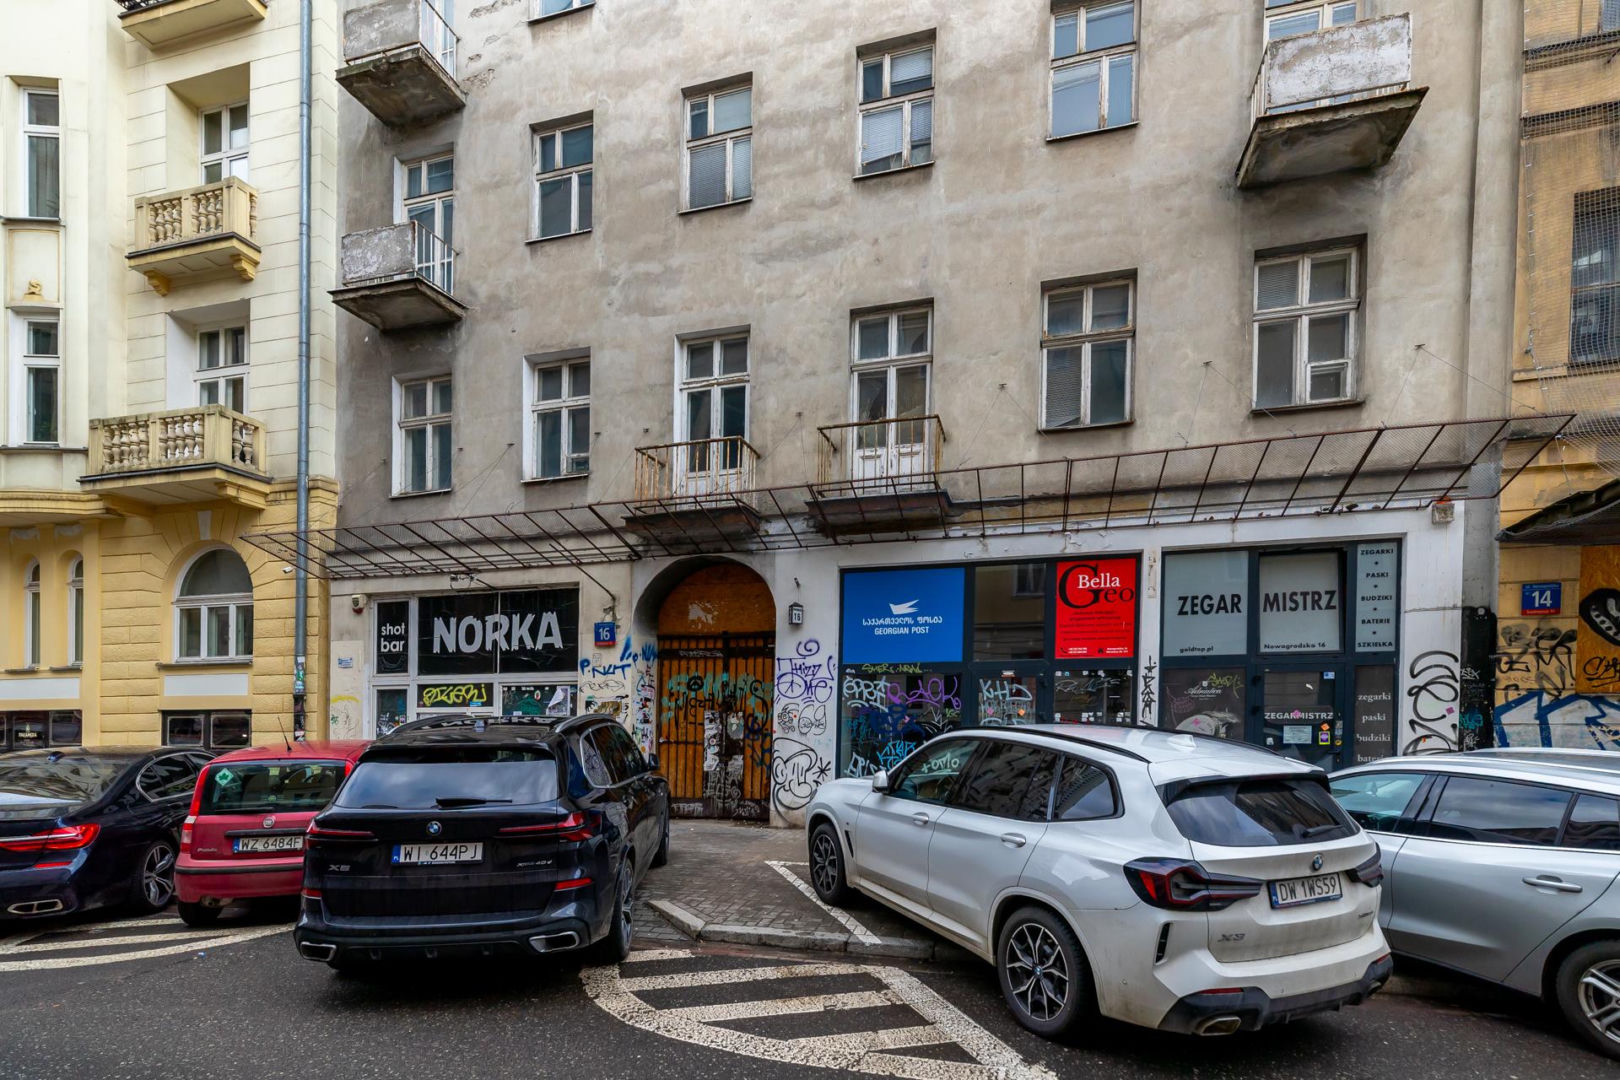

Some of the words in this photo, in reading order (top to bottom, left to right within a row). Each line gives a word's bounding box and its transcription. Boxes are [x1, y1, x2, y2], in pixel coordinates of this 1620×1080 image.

[1058, 563, 1134, 609] Geo
[1077, 572, 1121, 588] Bella
[1177, 593, 1242, 616] ZEGAR
[1262, 590, 1337, 613] MISTRZ
[1531, 590, 1553, 608] 14
[381, 622, 406, 636] shot
[433, 611, 563, 654] NORKA
[598, 627, 610, 641] 16
[874, 627, 909, 635] GEORGIAN
[911, 626, 930, 634] POST
[380, 638, 405, 652] bar
[1358, 692, 1391, 703] zegarki
[1362, 712, 1386, 724] paski
[241, 839, 259, 850] WZ
[262, 837, 301, 849] 6484F
[403, 846, 421, 861] WI
[429, 844, 478, 860] 644PJ
[1279, 882, 1297, 902] DW
[1301, 876, 1337, 898] 1WS59
